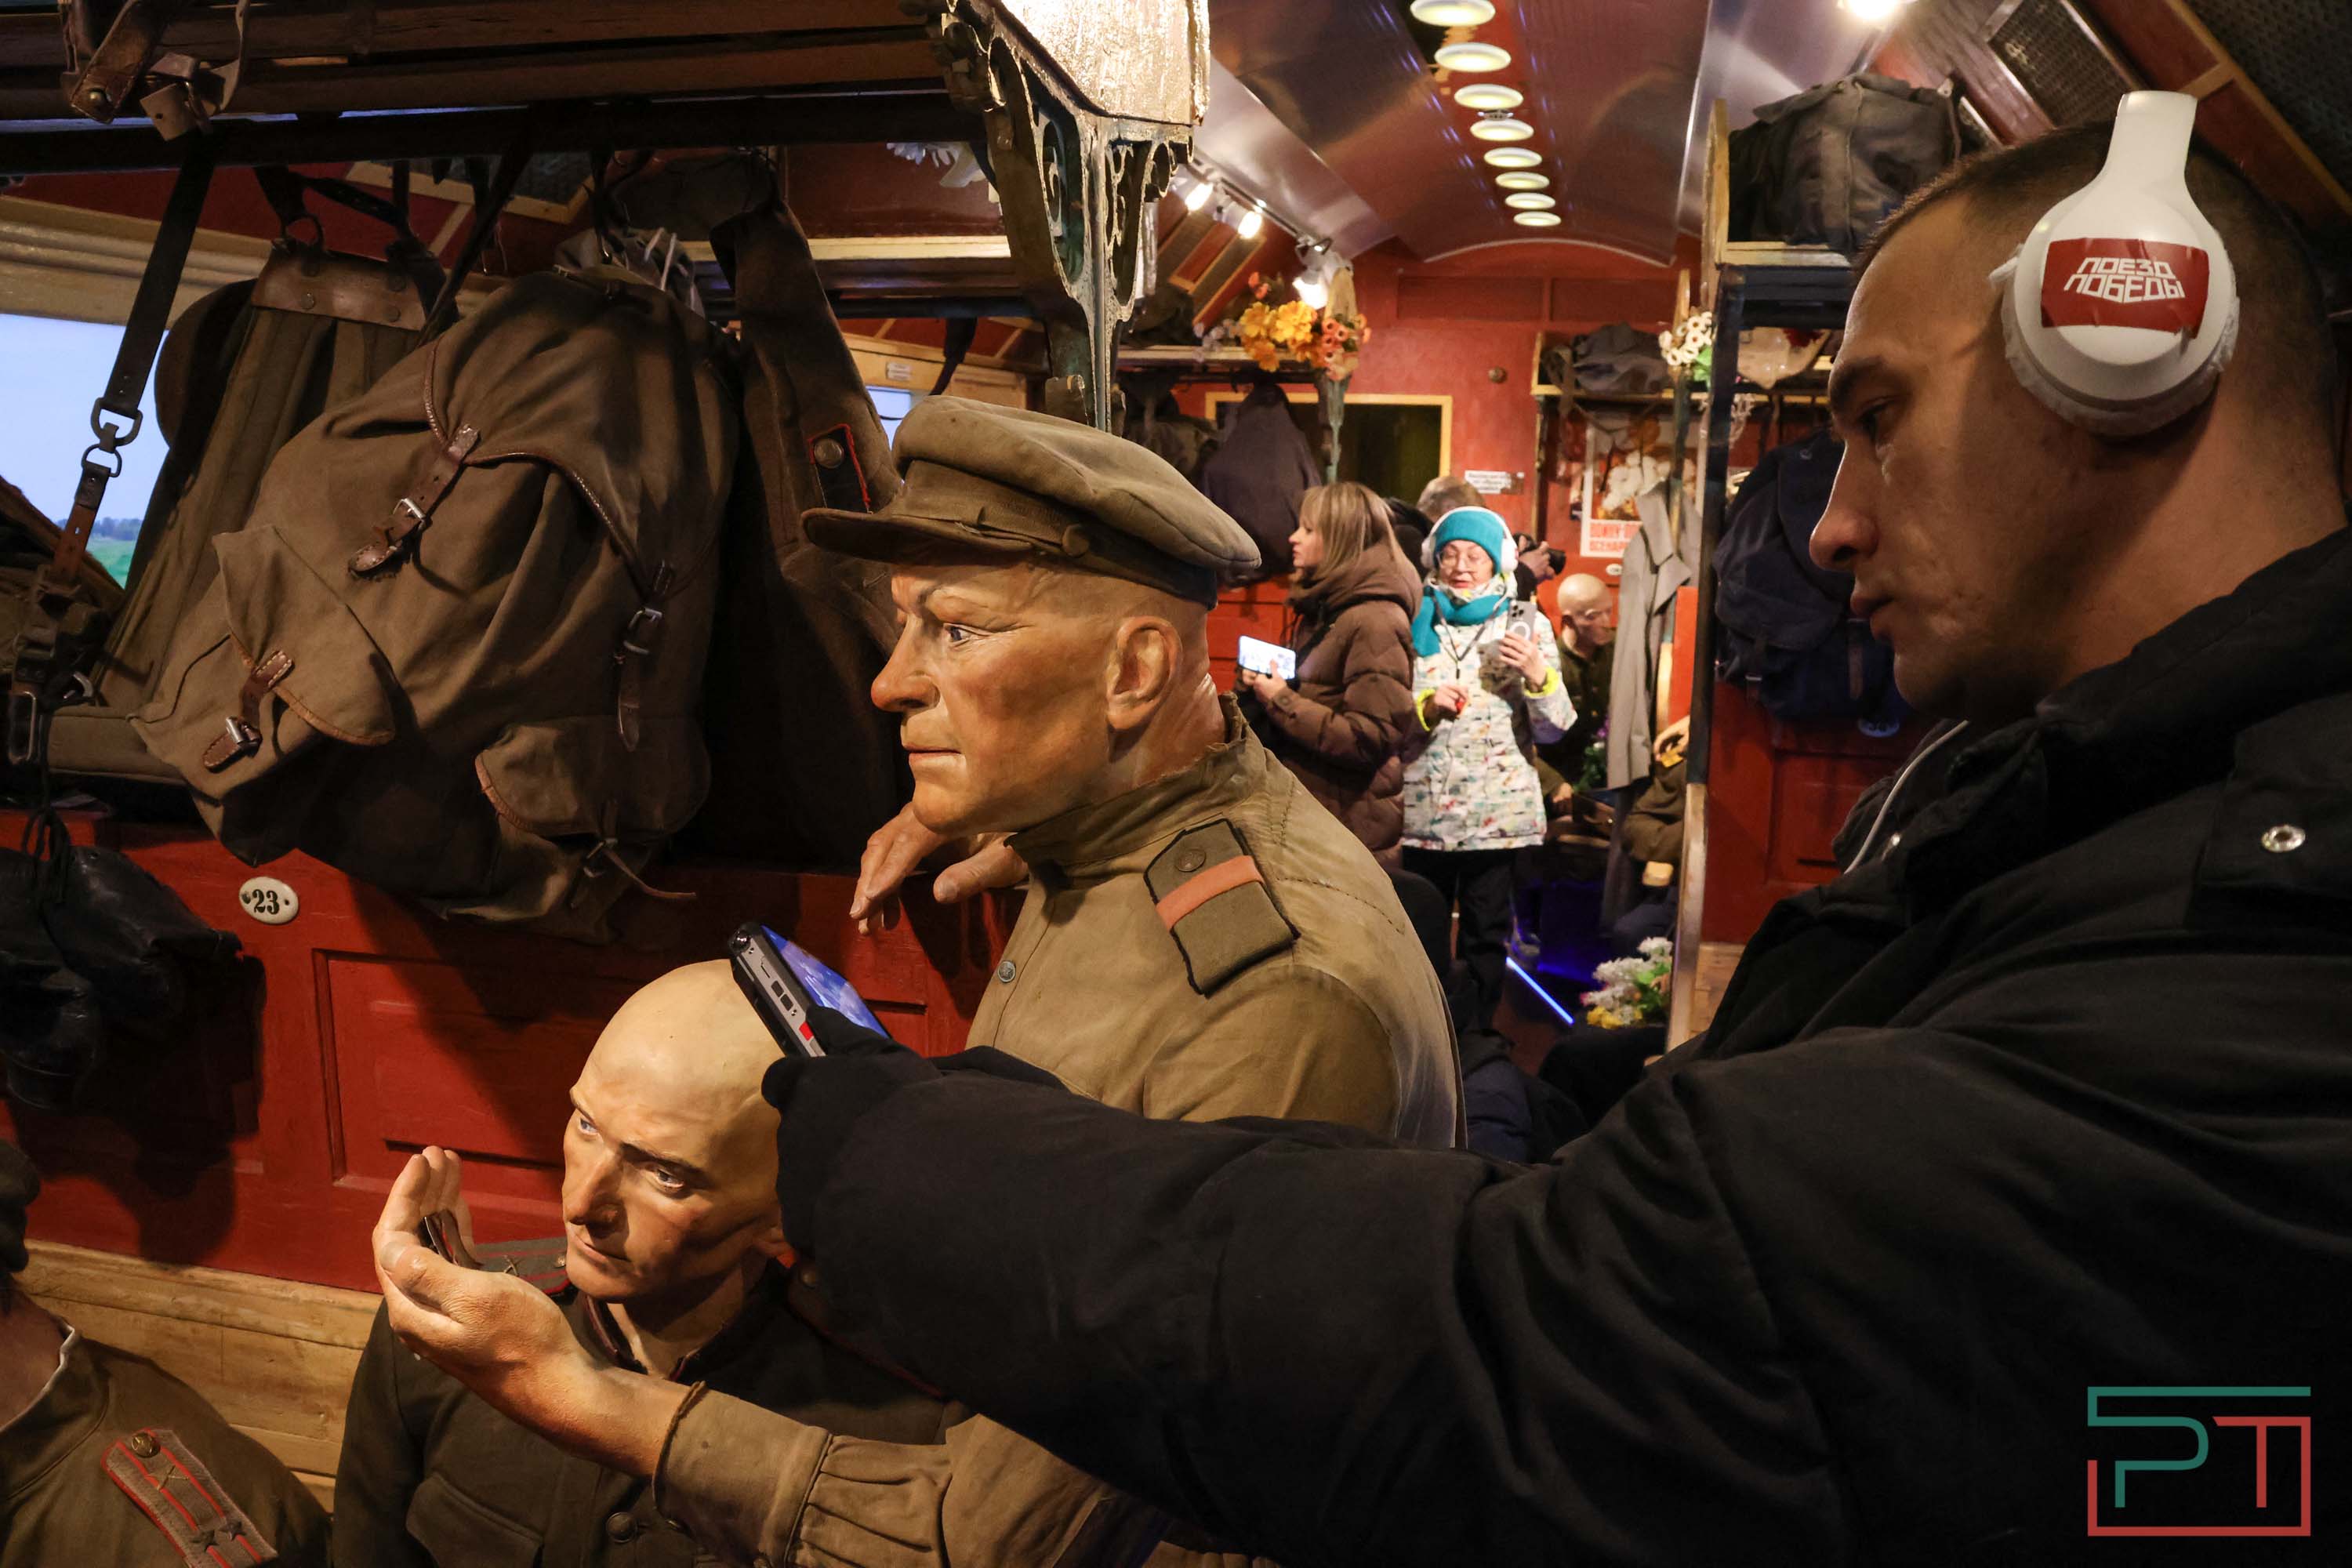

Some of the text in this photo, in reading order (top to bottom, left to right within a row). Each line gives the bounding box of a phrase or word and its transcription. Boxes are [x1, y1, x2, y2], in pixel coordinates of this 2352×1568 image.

[2076, 256, 2176, 279] ПОЕЗД
[2063, 273, 2186, 303] ПОБЕДЫ
[252, 888, 280, 915] 23
